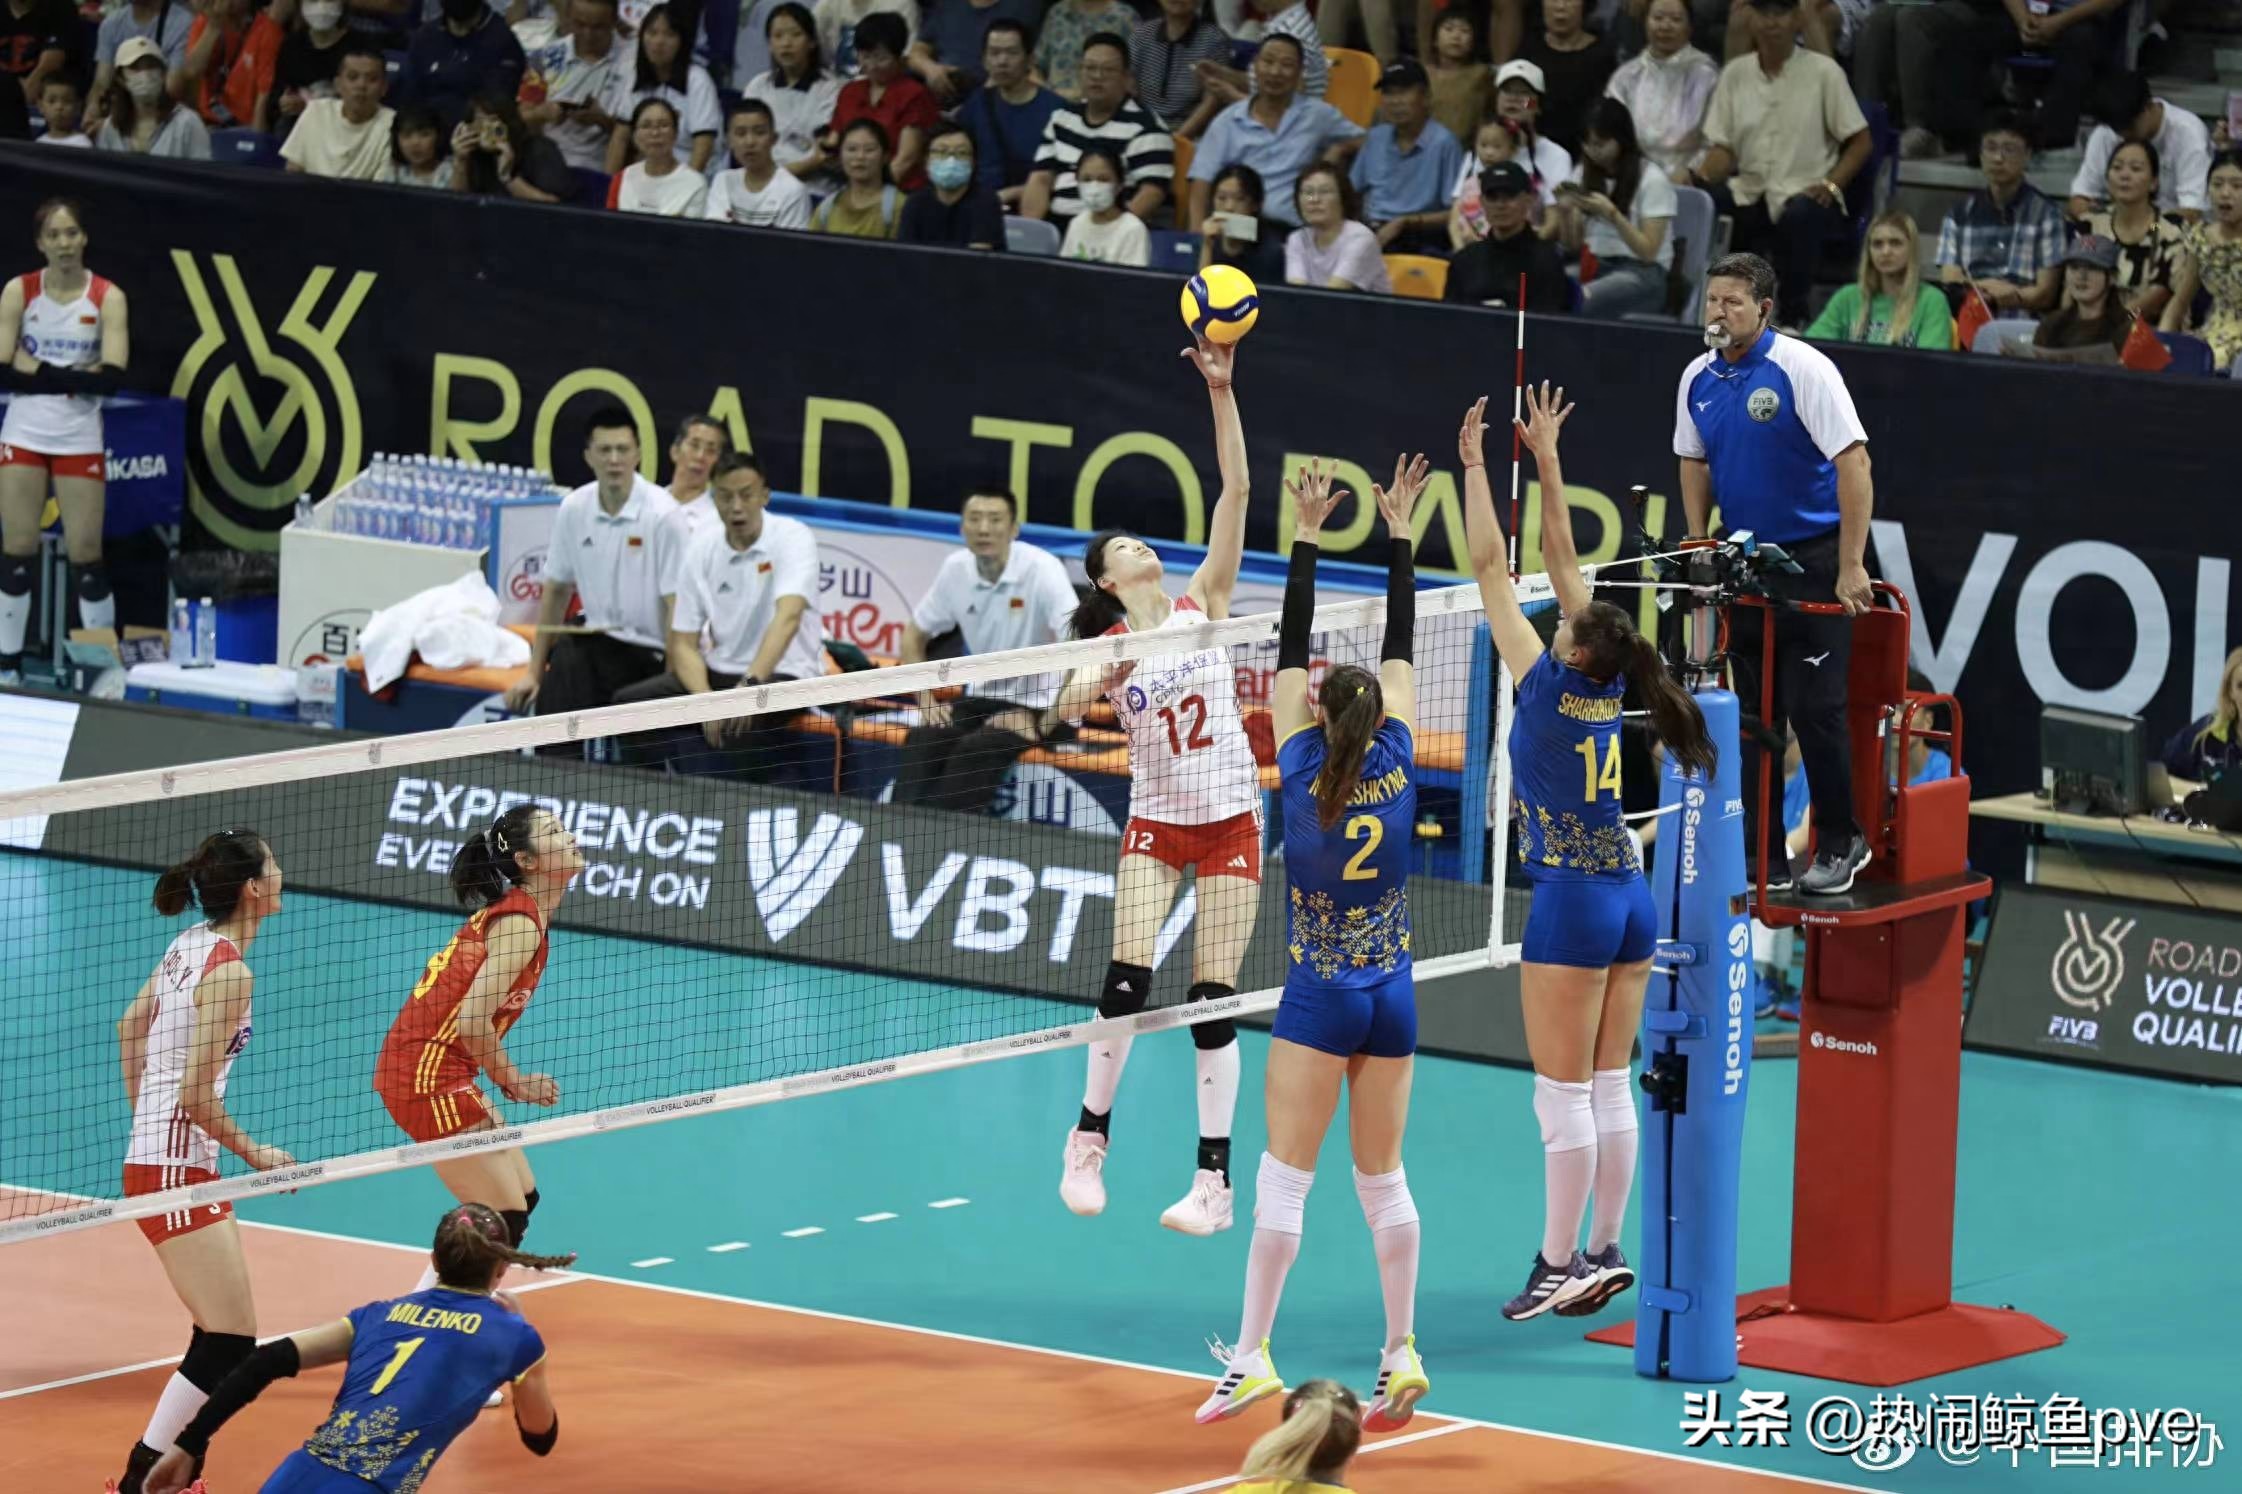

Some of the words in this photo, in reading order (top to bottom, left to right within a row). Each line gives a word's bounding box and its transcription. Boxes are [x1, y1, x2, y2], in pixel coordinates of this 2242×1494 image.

[1753, 397, 1774, 406] FIVB
[430, 353, 911, 509] ROAD
[970, 416, 1204, 545] TO
[1157, 694, 1214, 756] 12
[1575, 732, 1622, 802] 14
[1129, 830, 1154, 850] 12
[1343, 814, 1384, 881] 2
[1683, 809, 1701, 884] Senoh
[650, 872, 710, 909] ON
[1809, 914, 1840, 925] Senoh
[2148, 937, 2242, 977] ROAD
[1181, 1005, 1213, 1018] VOLLEYBALL
[1214, 1000, 1241, 1012] QUALIFIER
[1010, 1034, 1043, 1048] VOLLEYBALL
[1044, 1031, 1072, 1042] QUALIFIER
[1724, 962, 1747, 1095] Senoh
[2048, 1015, 2098, 1041] FIVB
[1825, 1036, 1878, 1056] Senoh
[831, 1070, 866, 1082] VOLLEYBALL
[867, 1064, 896, 1076] QUALIFIER
[646, 1101, 683, 1115] VOLLEYBALL
[684, 1095, 714, 1108] QUALIFIER
[452, 1137, 490, 1151] VOLLEYBALL
[492, 1131, 522, 1143] QUALIFIER
[250, 1175, 290, 1188] VOLLEYBALL
[291, 1167, 323, 1180] QUALIFIER
[36, 1216, 78, 1230] VOLLEYBALL
[79, 1208, 113, 1222] QUALIFIER
[385, 1302, 482, 1334] MILENKO
[369, 1337, 426, 1396] 1
